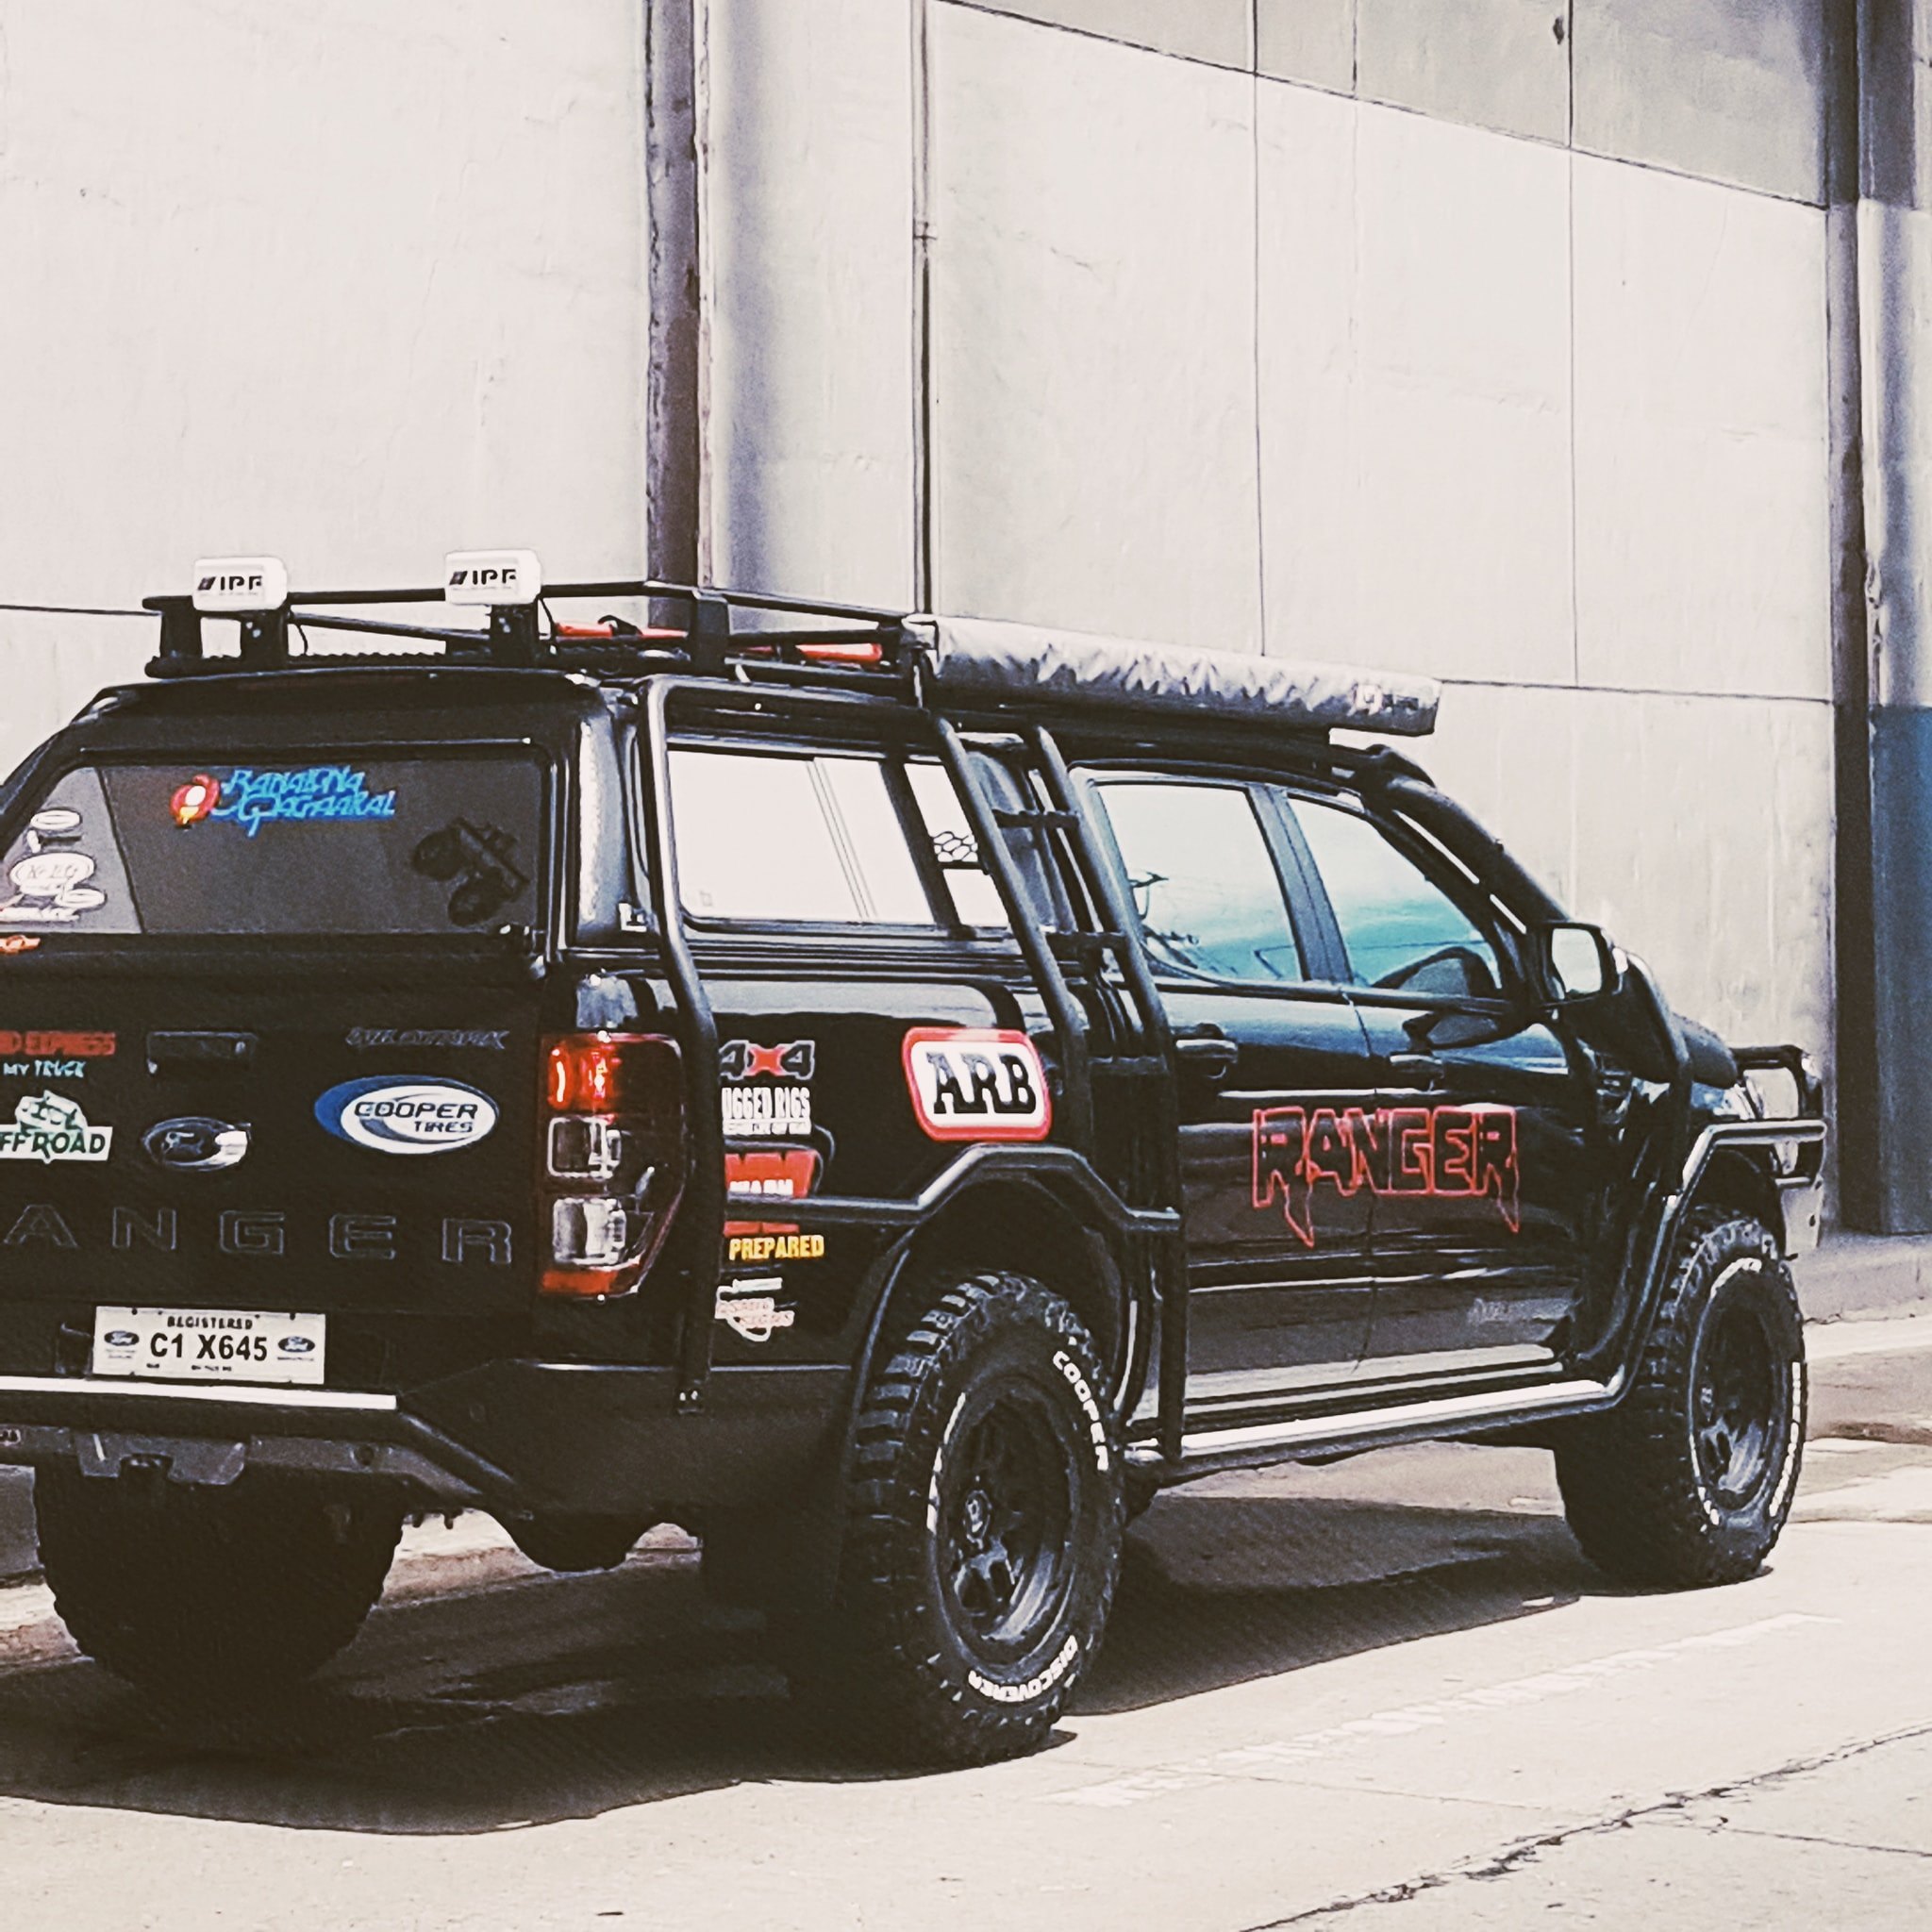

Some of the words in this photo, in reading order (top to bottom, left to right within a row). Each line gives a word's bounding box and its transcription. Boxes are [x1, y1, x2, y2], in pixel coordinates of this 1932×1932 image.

[220, 575, 263, 591] IPF
[473, 569, 517, 585] IPF
[3, 1061, 29, 1074] MY
[925, 1050, 1038, 1114] ARB
[354, 1101, 478, 1120] COOPER
[721, 1087, 773, 1120] UGGED
[414, 1120, 474, 1133] TIRES
[0, 1131, 106, 1158] FFROAD
[1251, 1105, 1521, 1247] RANGER
[3, 1204, 512, 1264] ANGER
[728, 1234, 825, 1260] PREPARED
[167, 1316, 253, 1330] REGISTERED
[150, 1332, 184, 1358] C1
[196, 1333, 268, 1361] X645
[1053, 1351, 1108, 1471] COOPER
